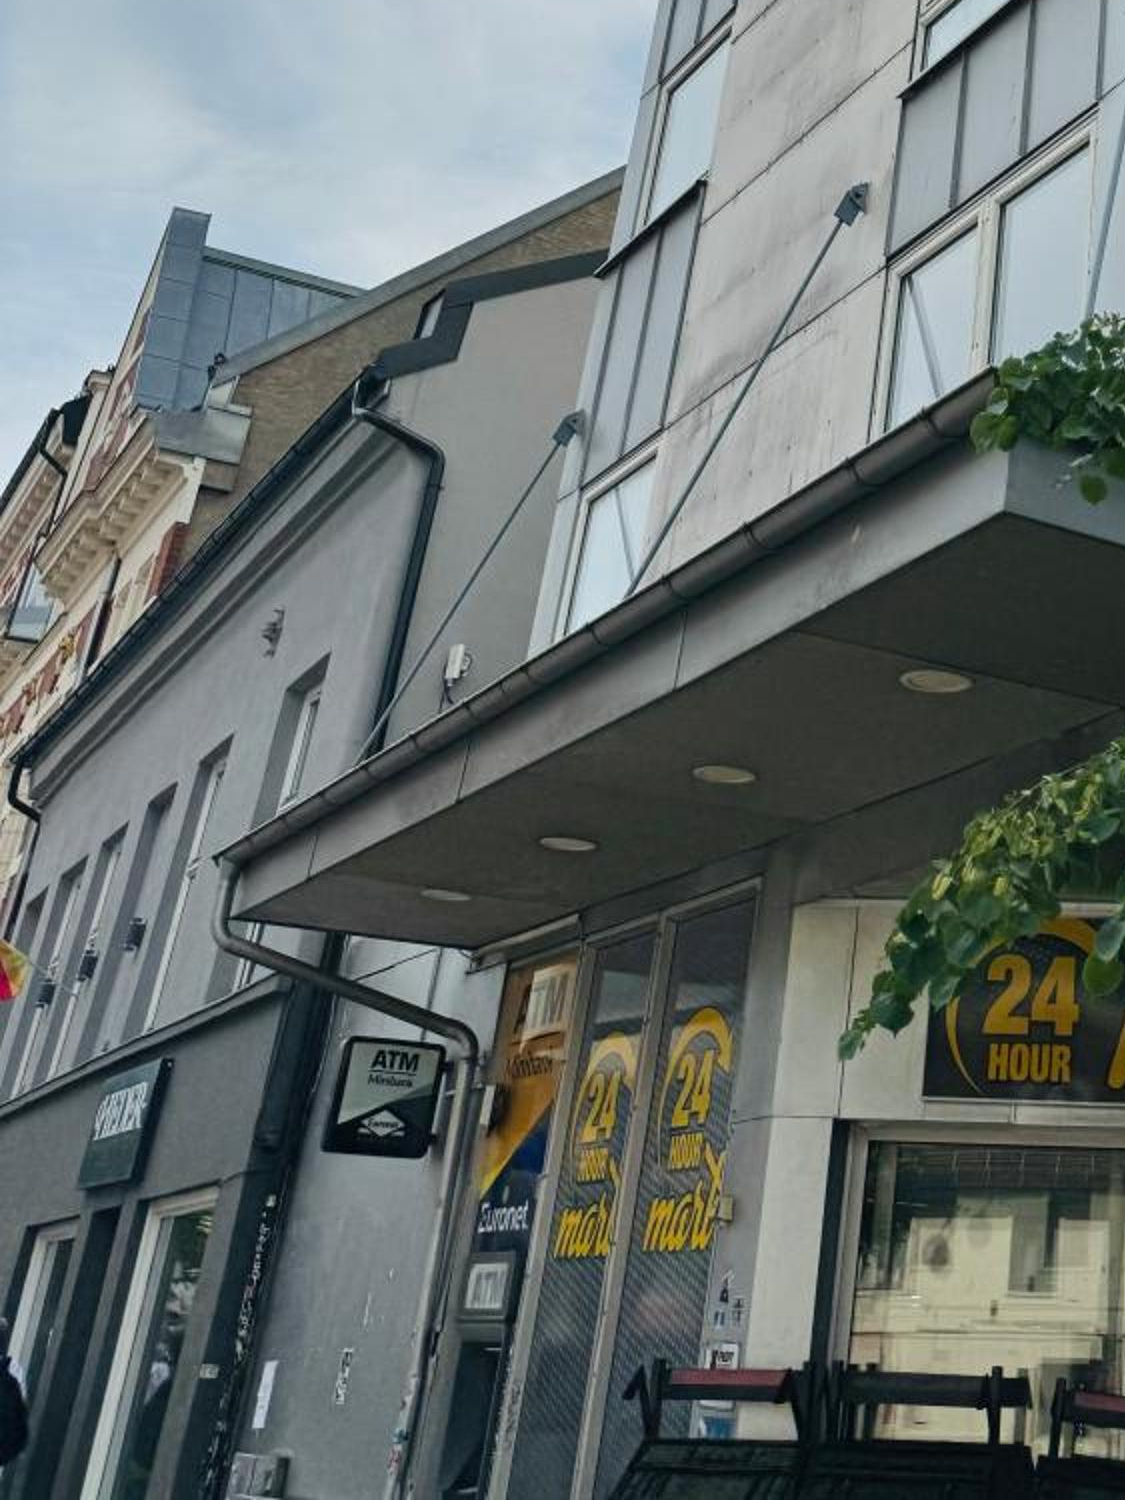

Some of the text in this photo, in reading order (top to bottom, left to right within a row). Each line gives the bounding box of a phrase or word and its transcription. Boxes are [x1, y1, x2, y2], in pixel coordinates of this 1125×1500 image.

[986, 954, 1079, 1036] 24
[371, 1049, 420, 1073] ATM
[672, 1049, 715, 1129] 24
[987, 1043, 1072, 1083] HOUR
[580, 1070, 621, 1143] 24
[477, 1199, 529, 1233] Euronet
